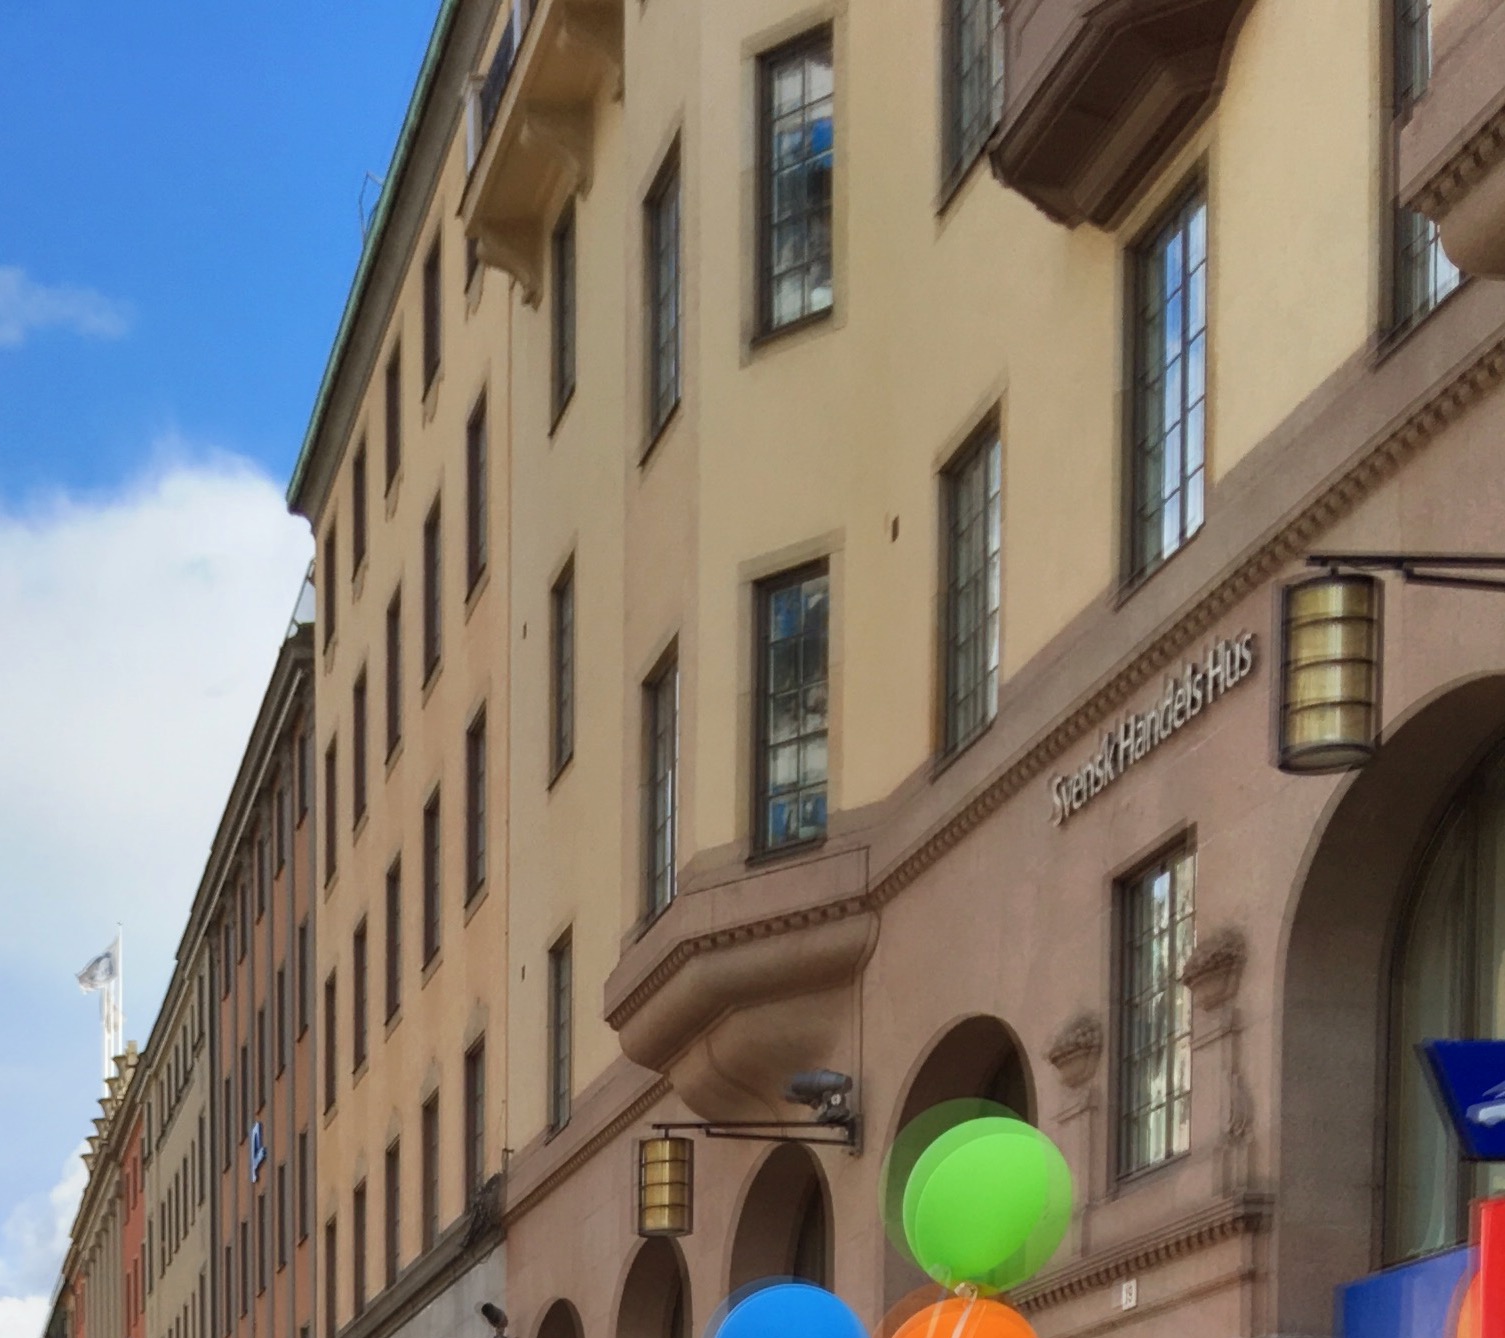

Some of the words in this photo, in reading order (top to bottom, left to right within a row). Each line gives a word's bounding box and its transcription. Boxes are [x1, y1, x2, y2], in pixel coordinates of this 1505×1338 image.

[1050, 729, 1117, 827] Svensk
[1113, 660, 1204, 774] Handels
[1206, 631, 1257, 704] Hus
